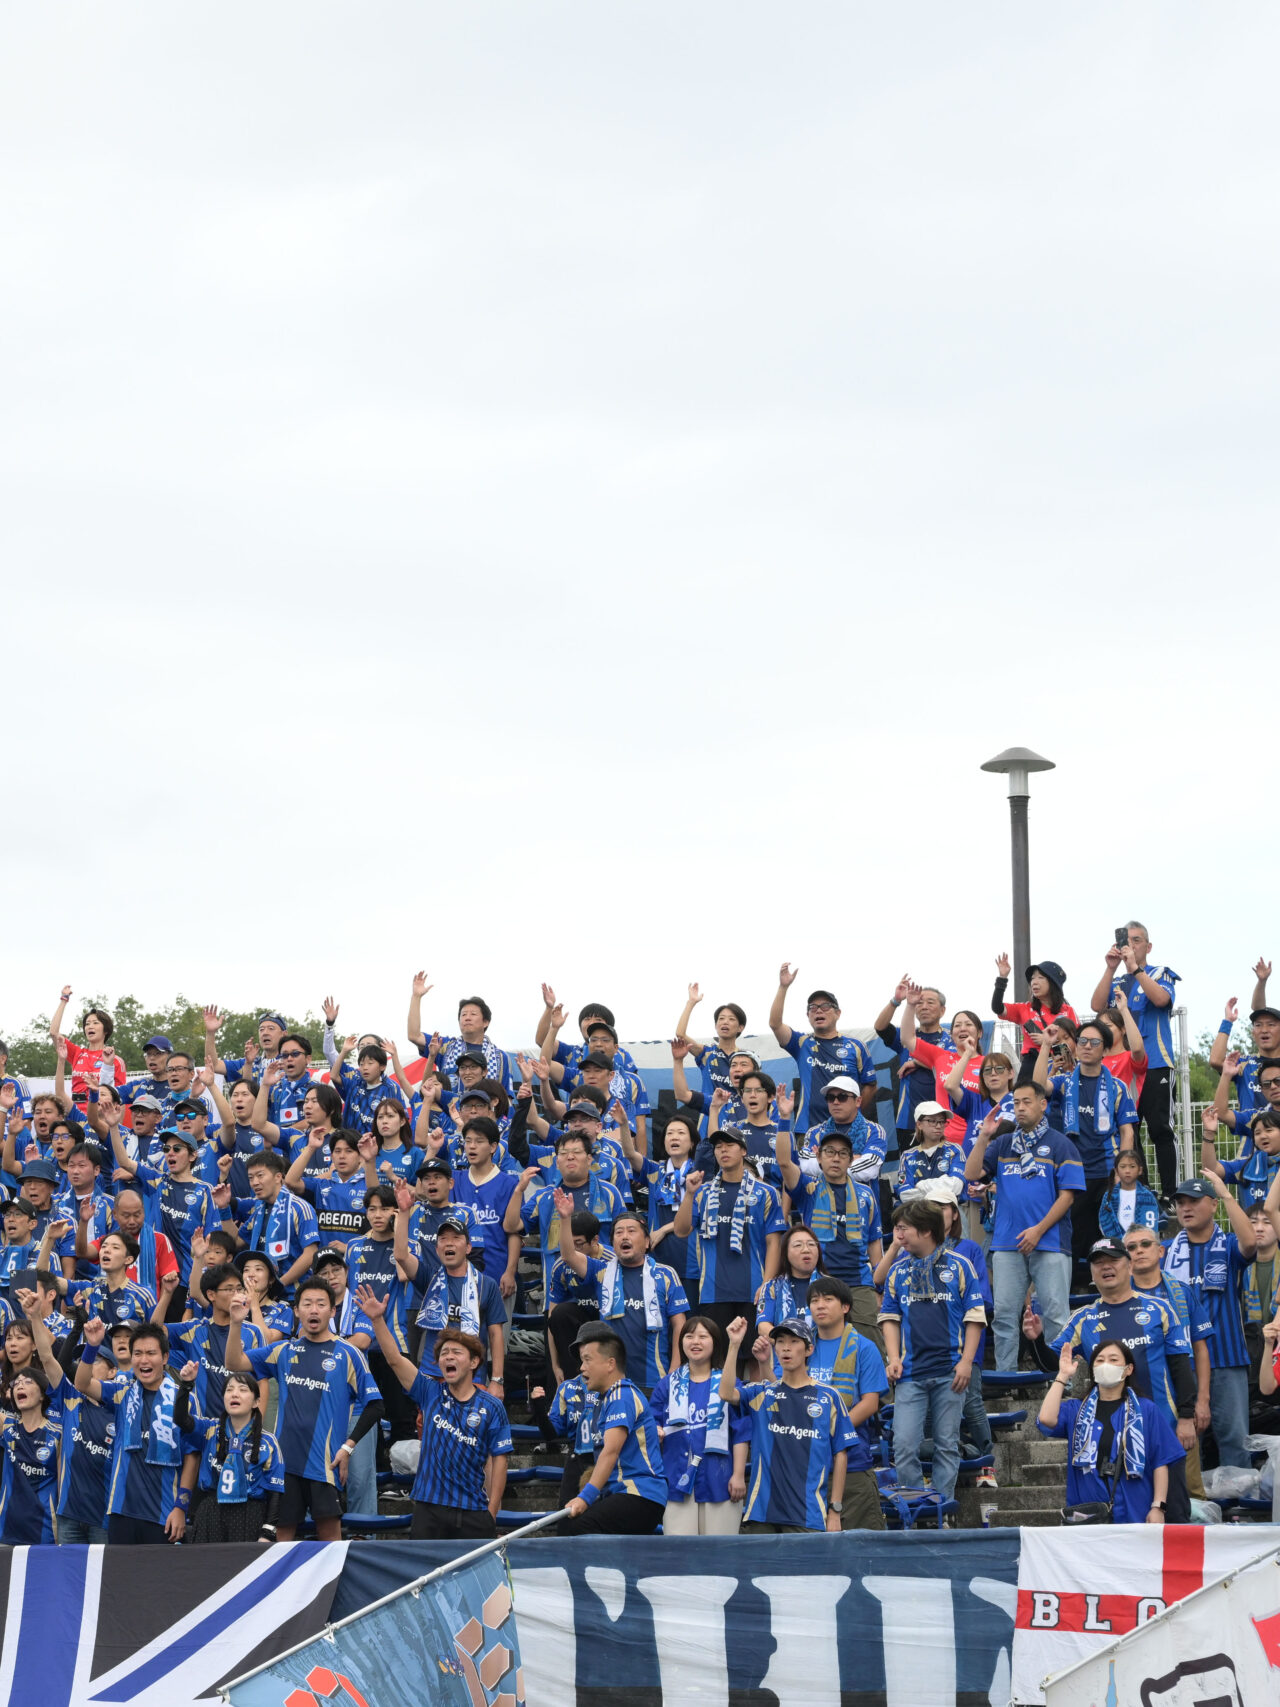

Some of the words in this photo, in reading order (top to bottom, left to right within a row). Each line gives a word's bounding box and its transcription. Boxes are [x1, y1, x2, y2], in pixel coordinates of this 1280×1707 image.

[319, 1212, 363, 1227] ABEMA
[1145, 1211, 1155, 1227] 9
[284, 1374, 331, 1392] yberAgent.
[222, 1470, 235, 1495] 9
